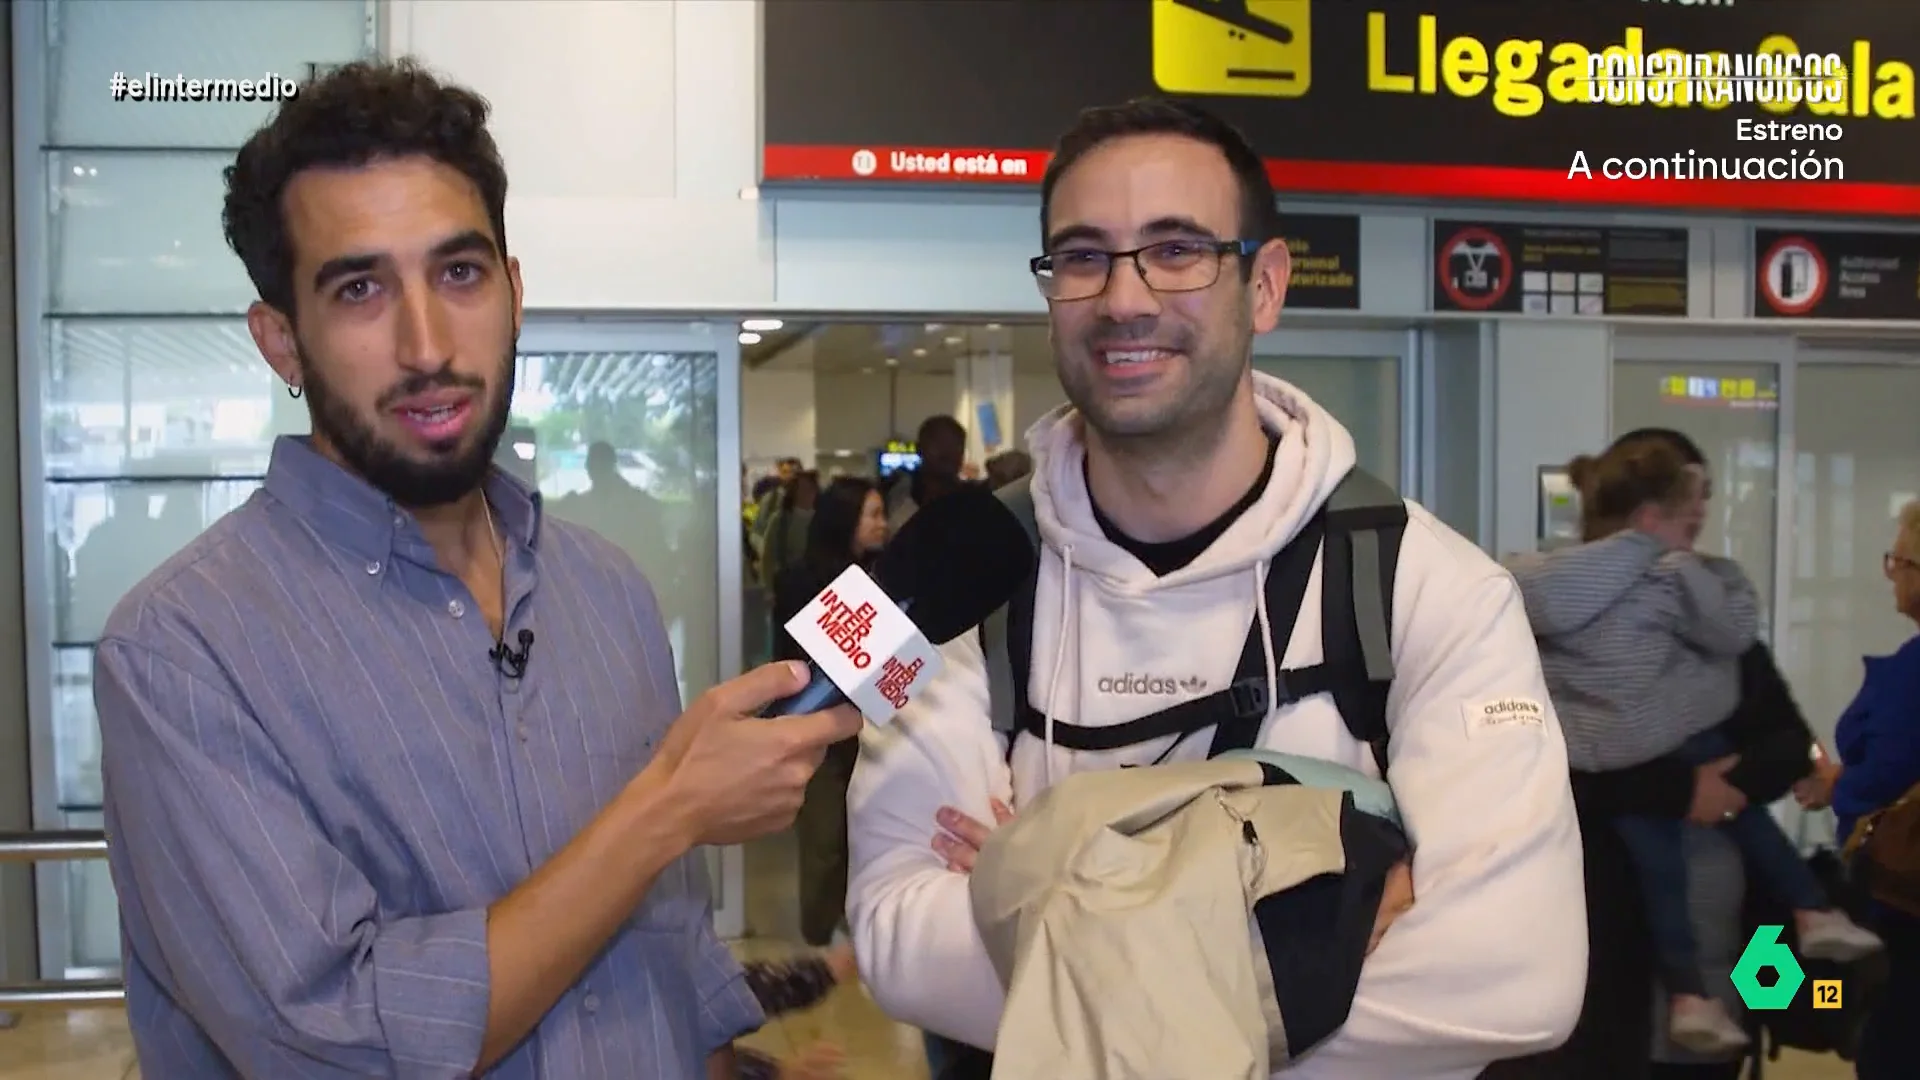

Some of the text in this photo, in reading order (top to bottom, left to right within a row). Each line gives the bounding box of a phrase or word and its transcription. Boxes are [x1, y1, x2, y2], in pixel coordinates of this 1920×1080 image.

[890, 151, 949, 173] Usted
[953, 153, 998, 175] está
[1001, 158, 1028, 175] en
[820, 589, 870, 642] INTER
[856, 602, 877, 628] EL
[816, 611, 871, 669] MEDIO
[1097, 672, 1177, 695] adidas
[1484, 700, 1531, 715] adidas
